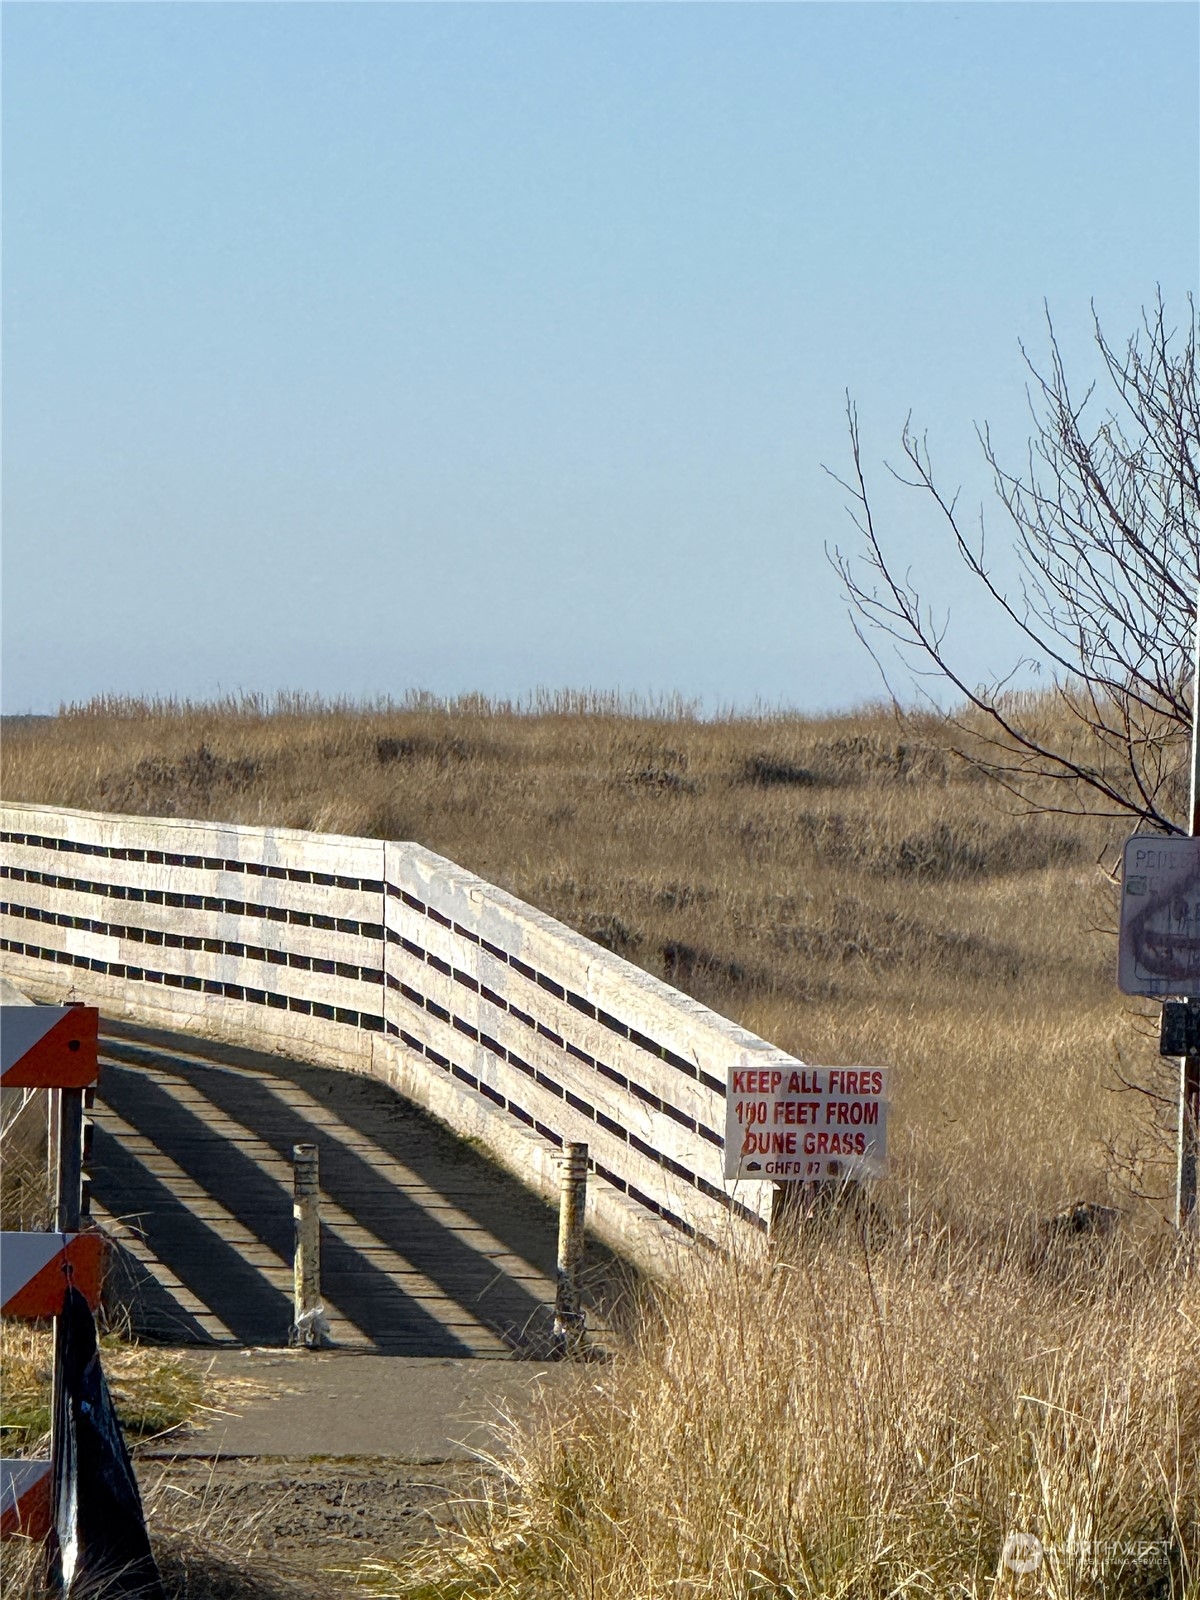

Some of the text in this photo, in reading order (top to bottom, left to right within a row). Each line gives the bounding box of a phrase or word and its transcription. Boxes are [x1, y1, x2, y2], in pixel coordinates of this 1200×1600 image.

[733, 1070, 883, 1095] KEEP ALL FIRES
[735, 1101, 878, 1125] 100 FEET FROM
[744, 1132, 866, 1155] DUNE GRASS
[765, 1161, 800, 1175] GHFD
